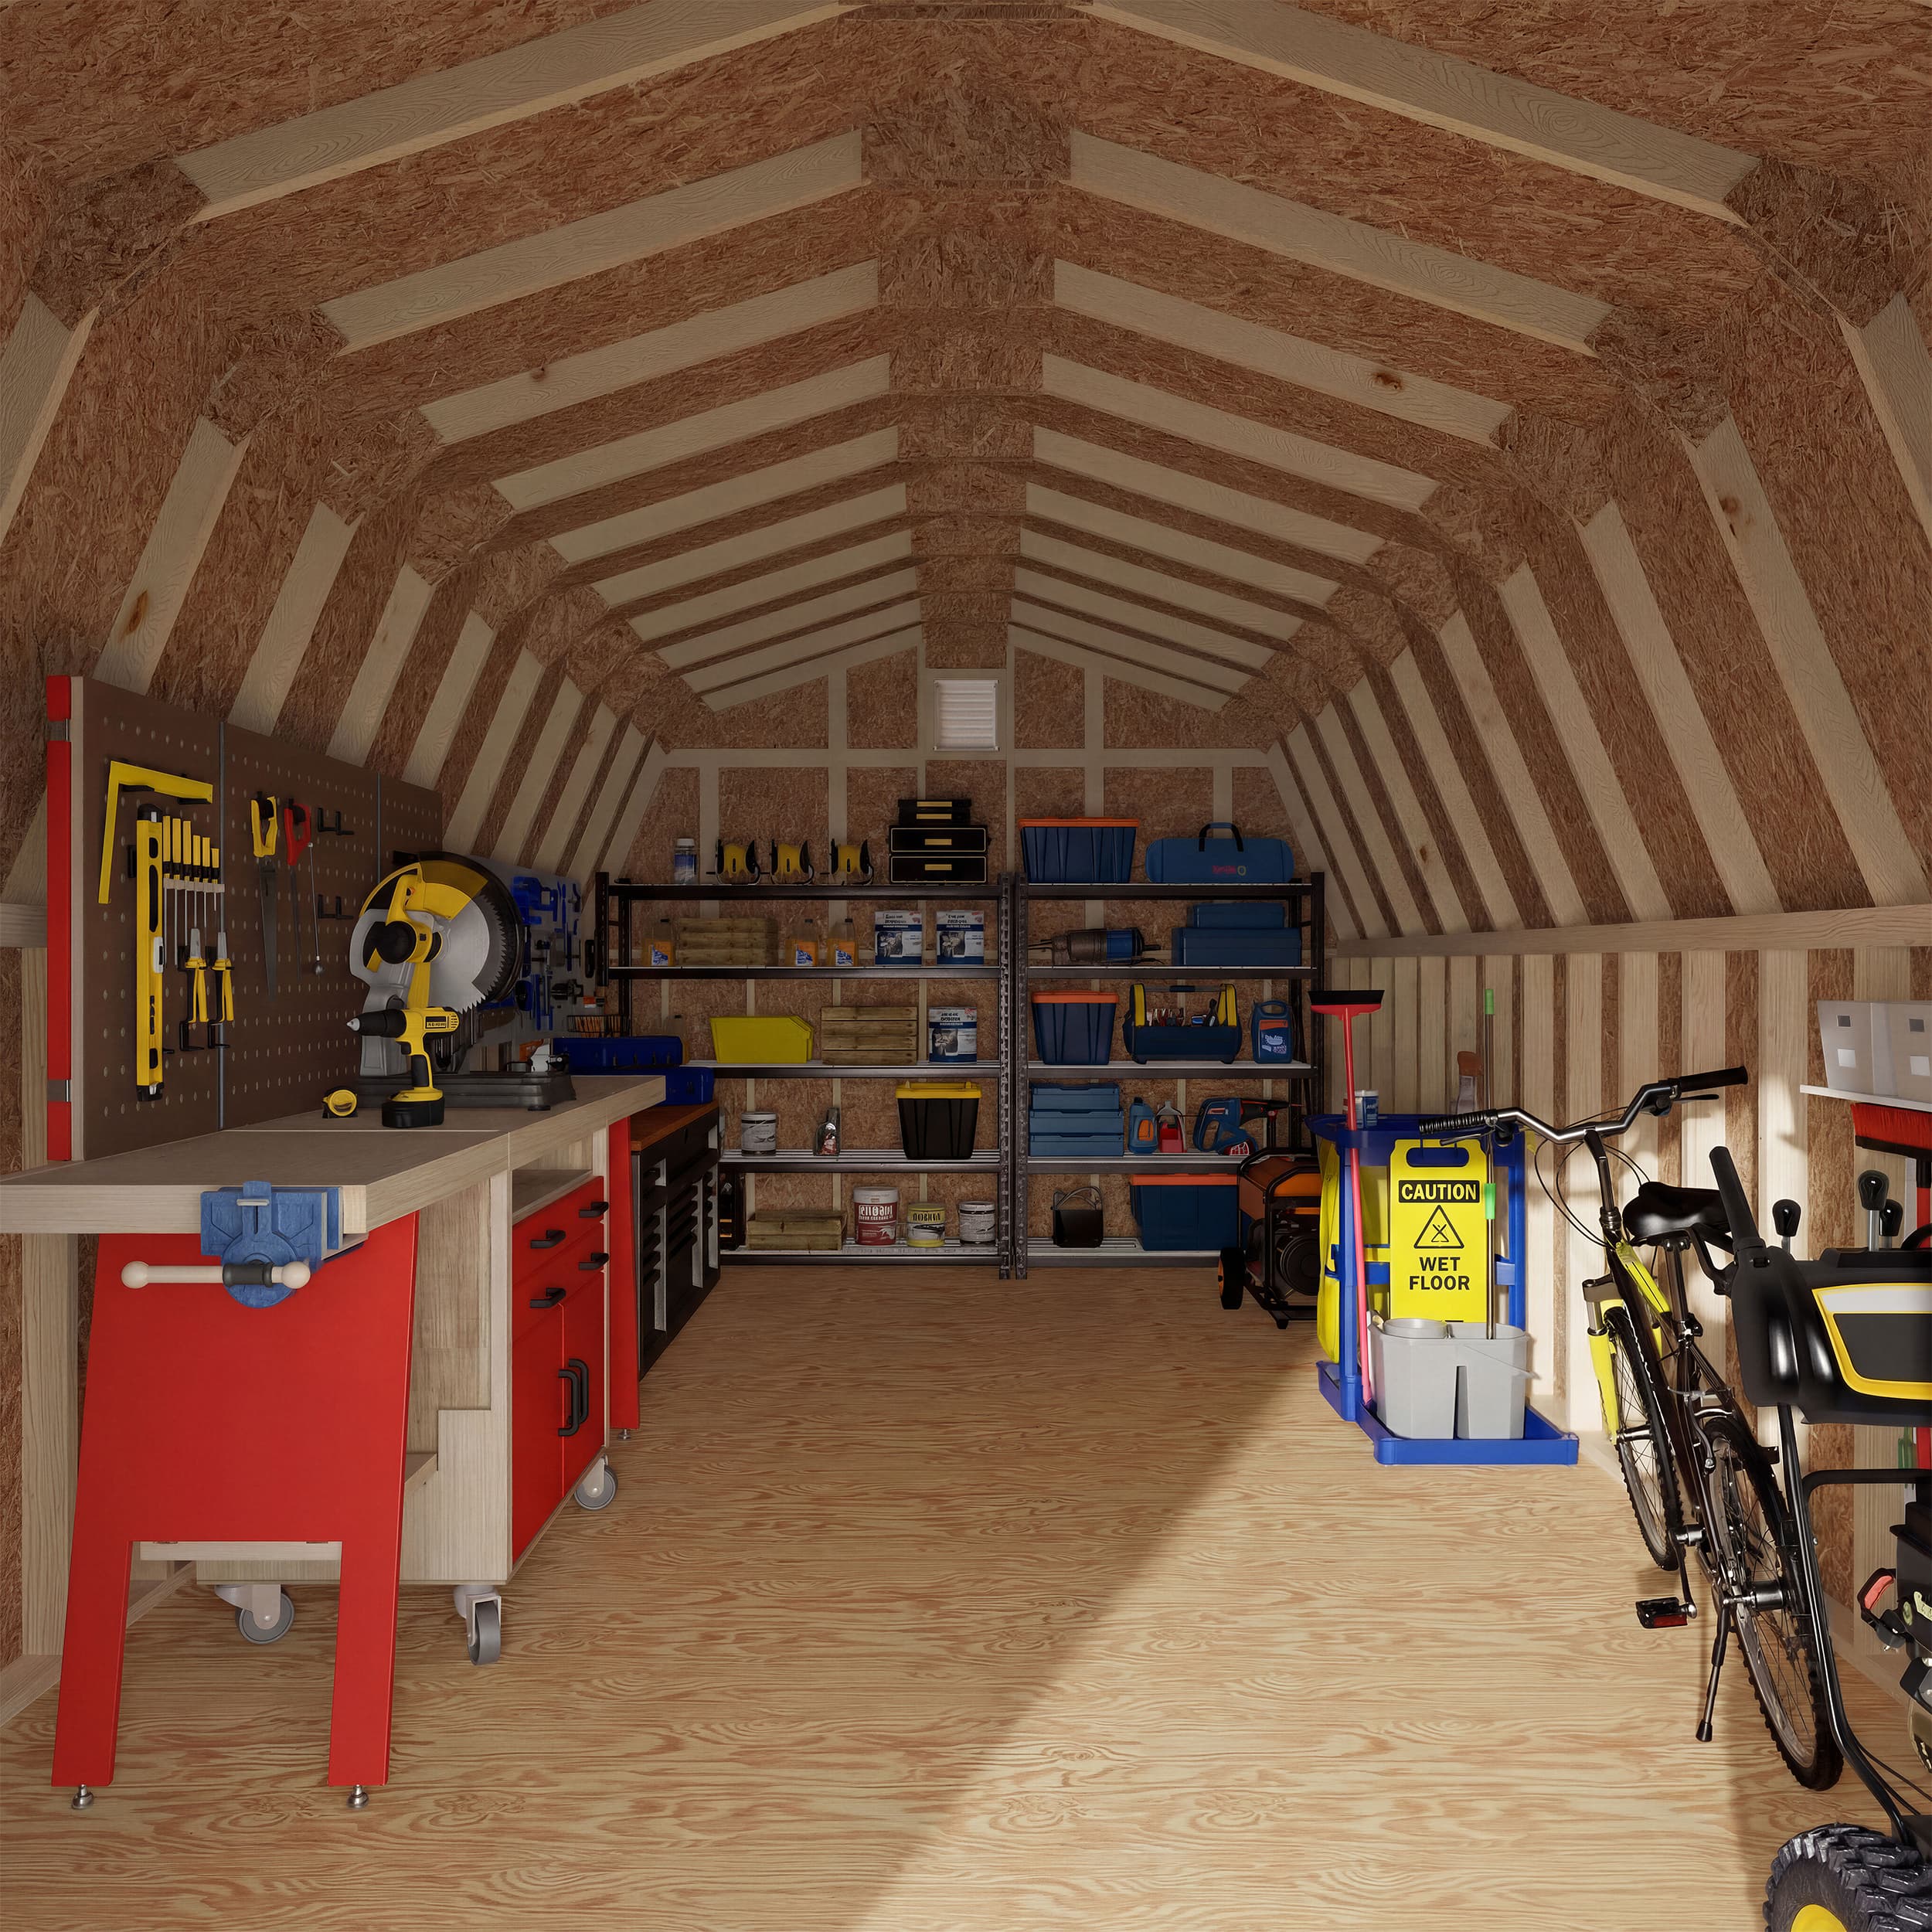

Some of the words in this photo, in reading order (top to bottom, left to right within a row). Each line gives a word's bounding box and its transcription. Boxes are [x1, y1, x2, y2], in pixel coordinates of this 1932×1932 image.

[1401, 1183, 1477, 1200] CAUTION
[1419, 1257, 1461, 1271] WET
[1409, 1275, 1470, 1291] FLOOR
